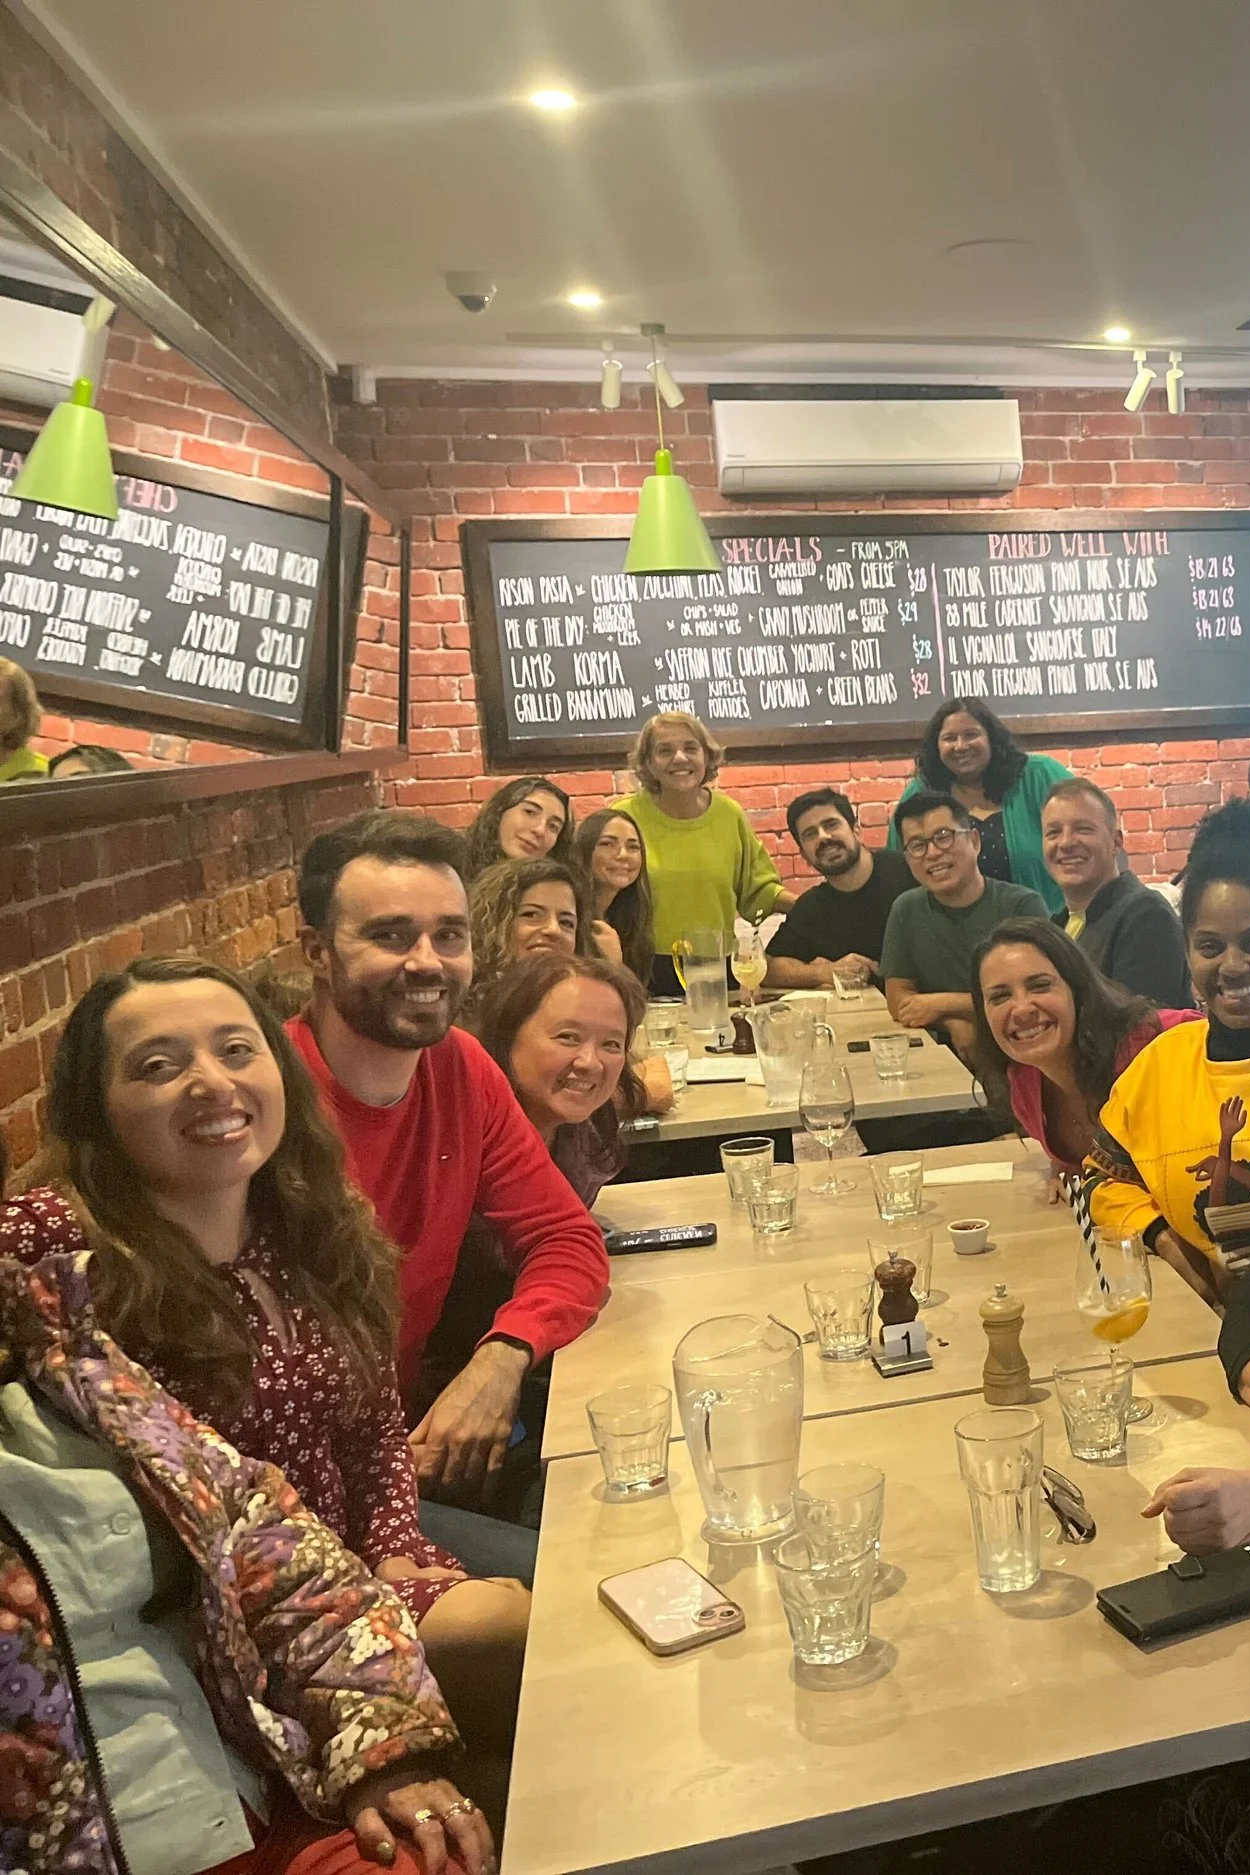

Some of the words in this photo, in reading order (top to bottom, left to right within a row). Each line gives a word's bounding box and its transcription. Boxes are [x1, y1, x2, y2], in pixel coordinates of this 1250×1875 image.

[721, 537, 822, 563] SPECIALS
[852, 541, 882, 560] FROM
[885, 539, 909, 560] 5PM
[988, 533, 1052, 559] PAIRED
[1060, 532, 1113, 557] WELL
[1123, 531, 1170, 556] WITH
[499, 576, 535, 607] RISON
[540, 574, 574, 605] PASTA
[776, 578, 803, 596] ONION
[826, 561, 854, 592] GOATS
[861, 561, 896, 590] CHEESE
[906, 562, 928, 597] $28
[943, 566, 985, 598] TAYLOR
[989, 563, 1046, 596] FERGUSON
[1050, 559, 1081, 593] PINOT
[1116, 556, 1132, 589] SE
[1134, 556, 1158, 588] AUS
[593, 602, 633, 622] CHICKEN
[681, 622, 693, 636] OR
[694, 620, 718, 637] MASH
[724, 618, 742, 635] VEG
[792, 602, 846, 635] MUSHROOM
[860, 597, 889, 616] PEPPER
[897, 598, 919, 626] $29
[861, 615, 887, 633] SAUCE
[962, 601, 989, 628] MILE
[994, 596, 1043, 627] CABERNET
[1108, 592, 1124, 621] SE
[1128, 590, 1149, 621] AUS
[504, 618, 523, 649] PIE
[525, 618, 539, 648] OF
[542, 616, 565, 648] THE
[617, 629, 641, 646] LEEK
[1026, 627, 1087, 662] SANGIOVESE
[1091, 625, 1117, 658] ITALY
[510, 653, 556, 689] LAMB
[573, 650, 626, 687] KORMA
[664, 646, 711, 682] SAFFRON
[711, 646, 735, 679] RICE
[737, 645, 788, 677] CUCUMBER
[791, 641, 835, 674] YOGHURT
[851, 638, 882, 671] ROTI
[912, 633, 933, 665] $28
[950, 669, 989, 698] TAYLOR
[992, 666, 1043, 697] FERGUSON
[1047, 663, 1077, 696] PINOT
[1115, 660, 1132, 690] SE
[1136, 657, 1158, 690] AUS
[514, 692, 562, 723] GRILLED
[566, 687, 637, 721] BARRAMUNDI
[654, 683, 690, 701] HERBED
[759, 677, 811, 710] CAPONATA
[827, 675, 864, 706] GREEN
[864, 671, 898, 705] BEANS
[910, 667, 932, 699] $32
[901, 1331, 912, 1356] 1
